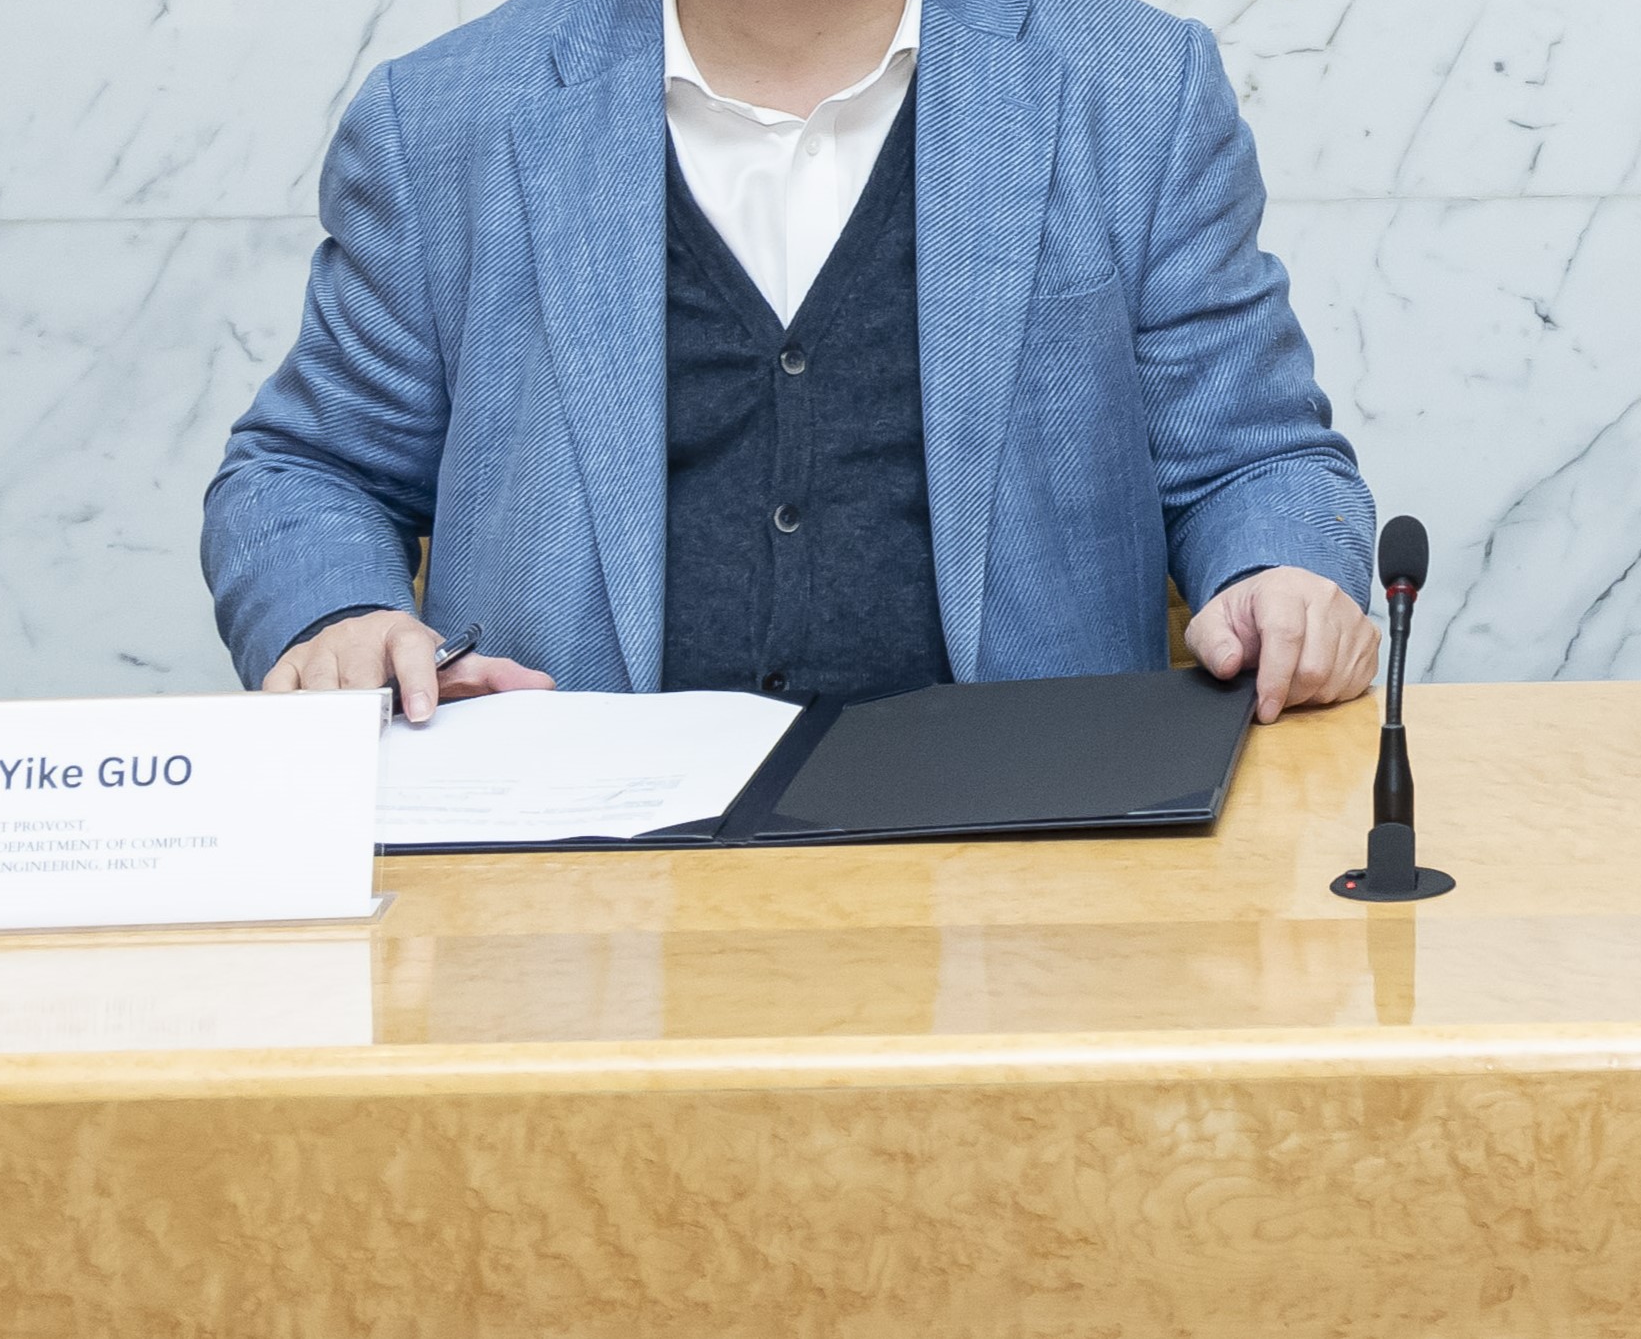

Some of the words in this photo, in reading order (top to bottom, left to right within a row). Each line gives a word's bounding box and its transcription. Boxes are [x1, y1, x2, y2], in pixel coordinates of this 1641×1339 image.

[97, 754, 192, 788] GUO
[106, 837, 127, 850] OF
[131, 835, 219, 850] COMPUTER
[106, 857, 160, 870] HKUST
